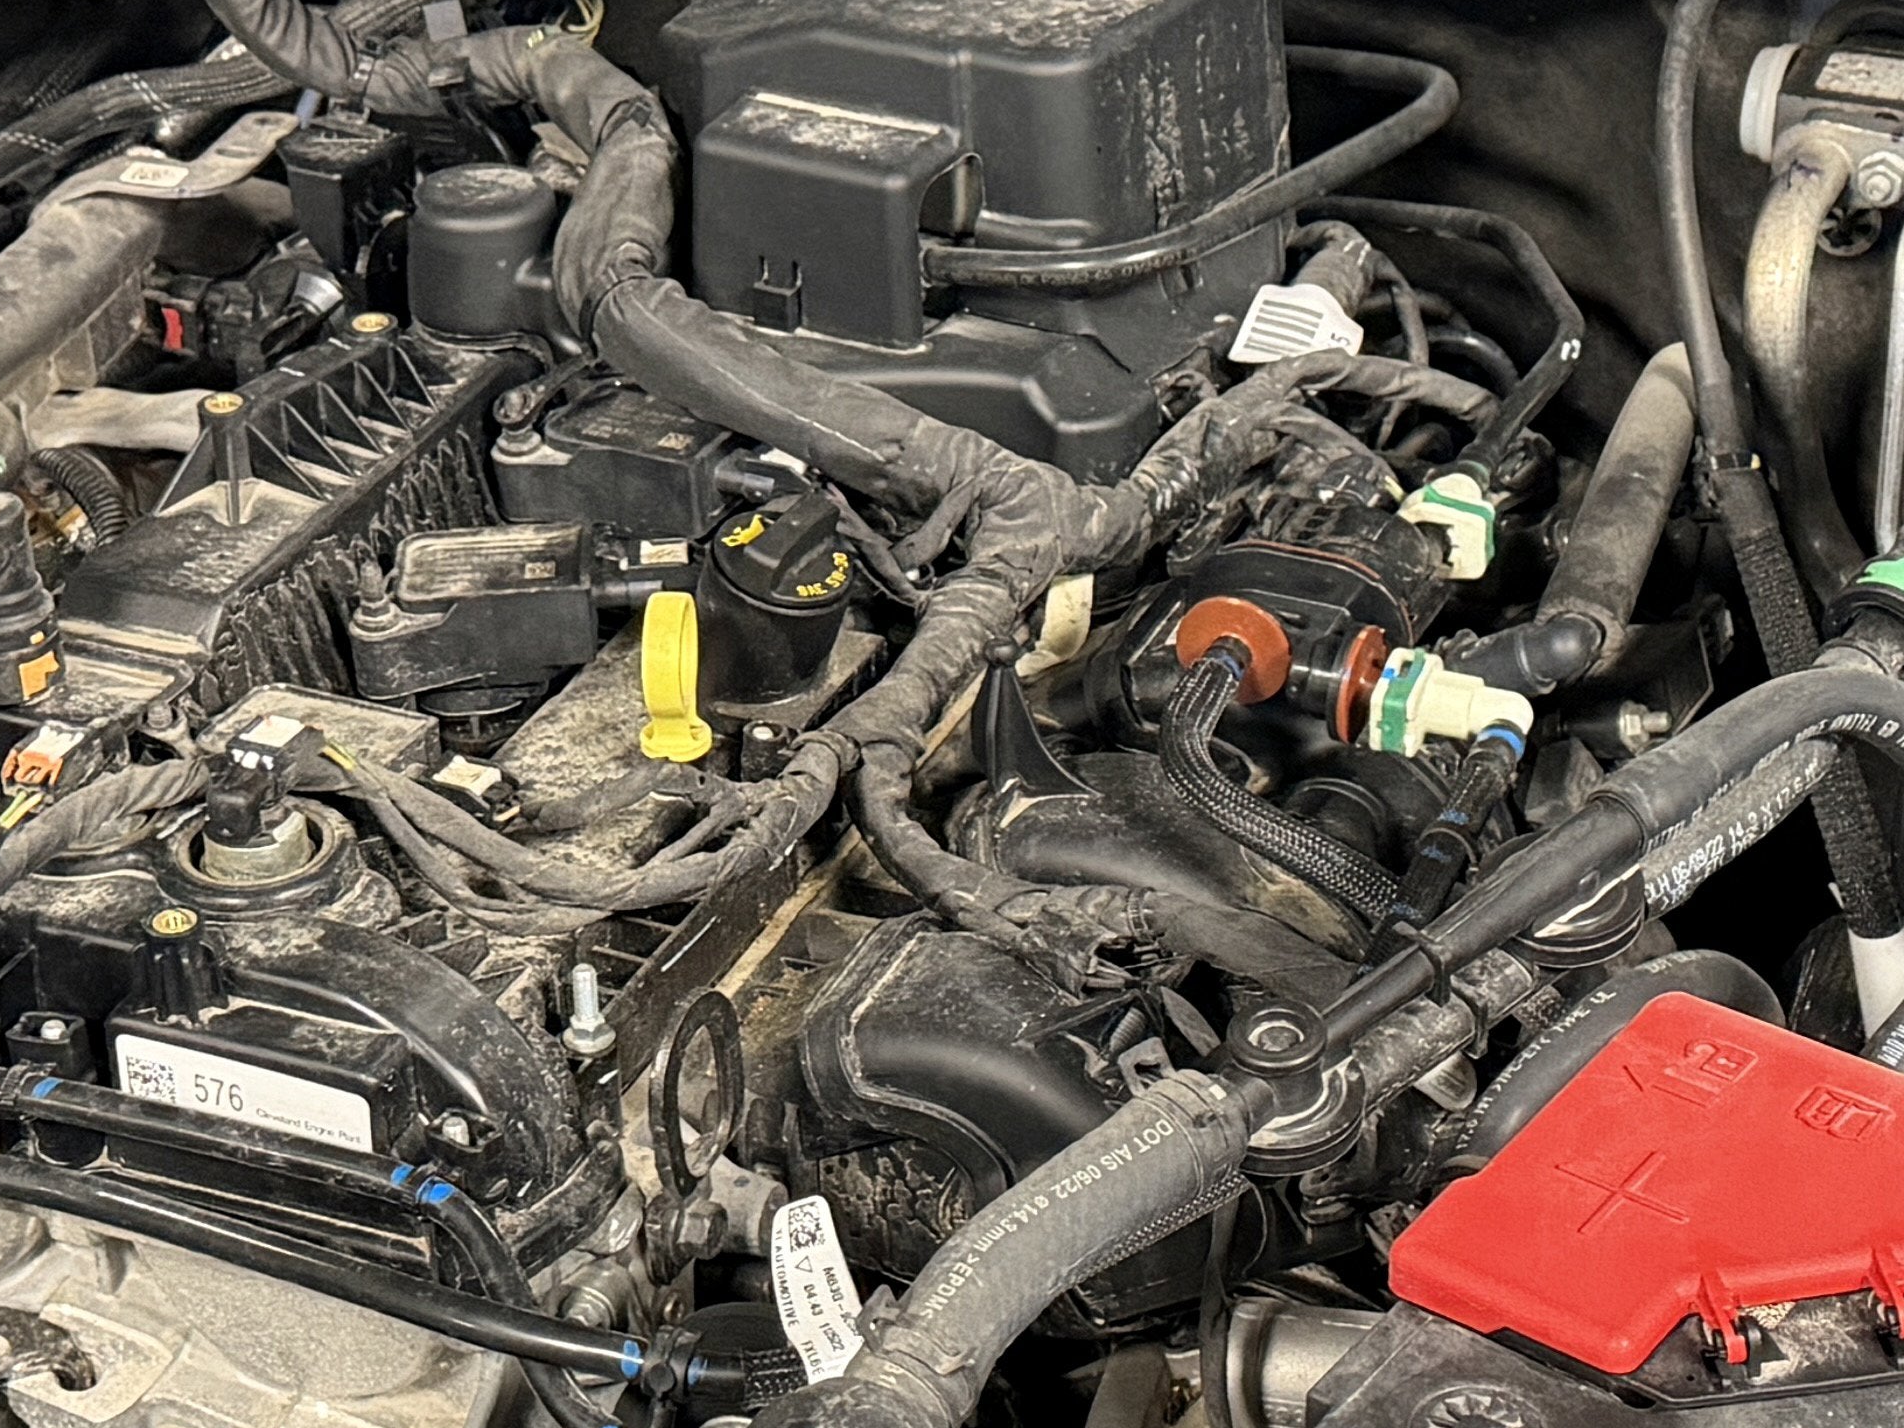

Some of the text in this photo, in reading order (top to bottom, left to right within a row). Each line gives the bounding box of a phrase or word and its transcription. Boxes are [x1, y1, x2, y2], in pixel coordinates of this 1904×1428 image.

[188, 1073, 247, 1112] 576
[1128, 1115, 1175, 1156] DOT
[1097, 1141, 1137, 1173] AIS
[1049, 1160, 1104, 1202] 06/22
